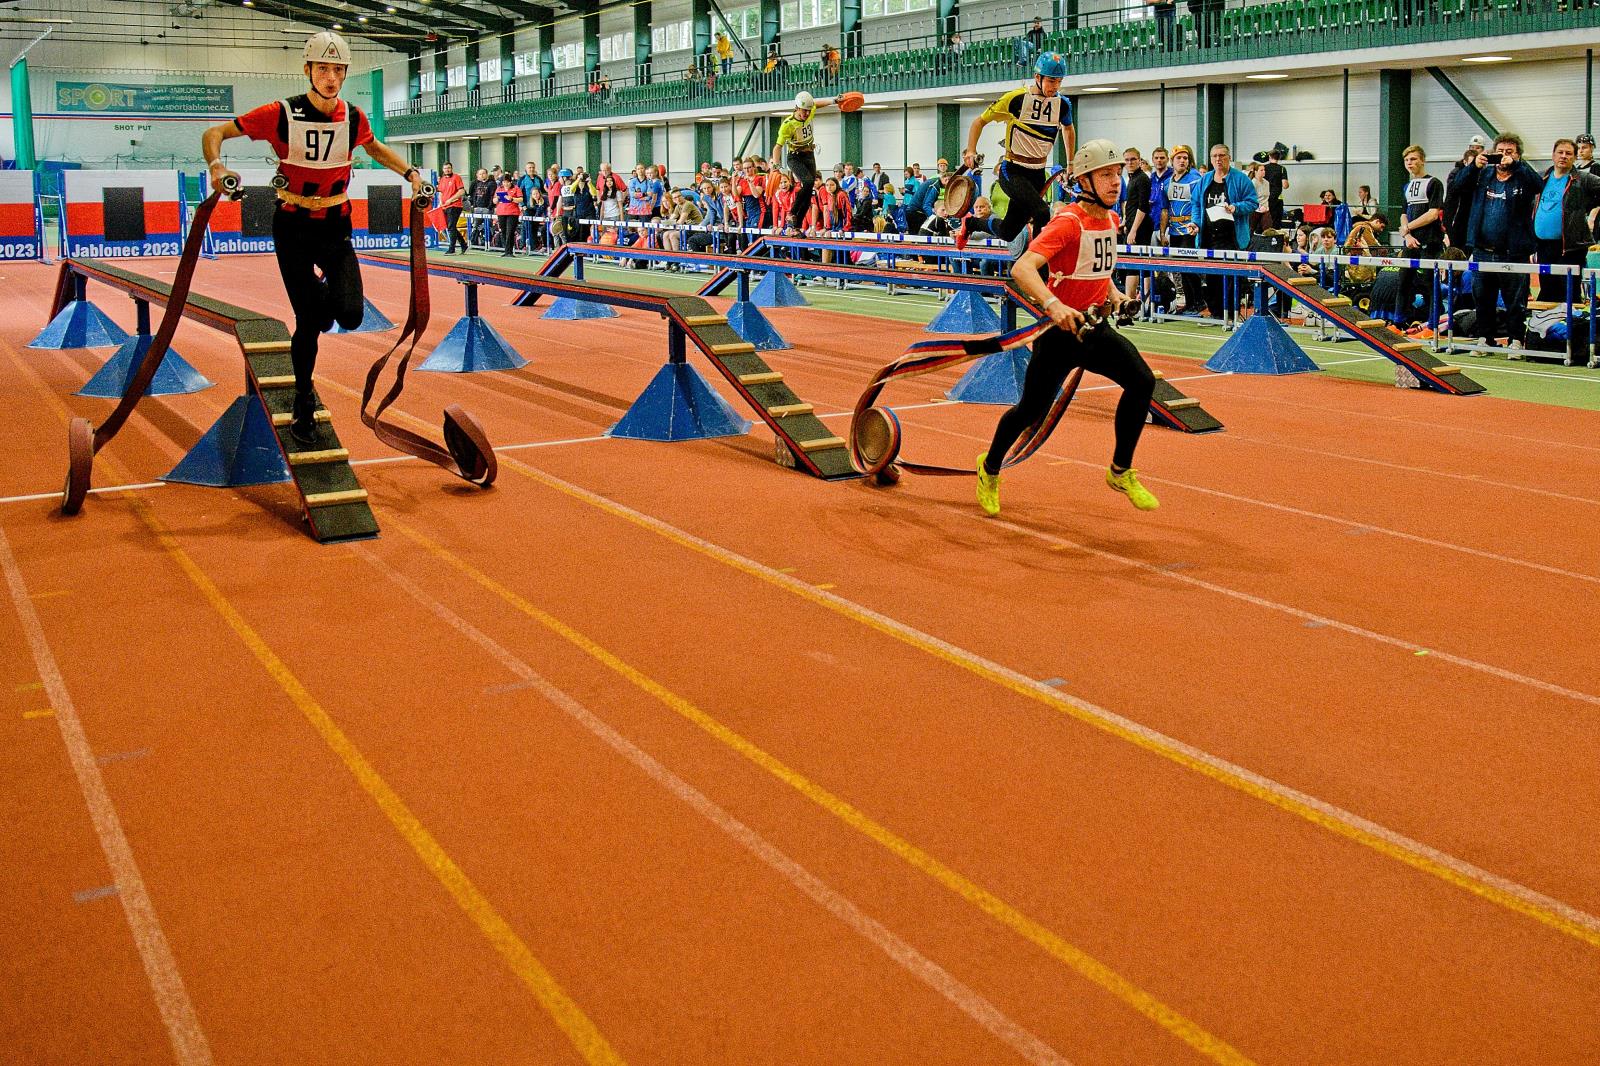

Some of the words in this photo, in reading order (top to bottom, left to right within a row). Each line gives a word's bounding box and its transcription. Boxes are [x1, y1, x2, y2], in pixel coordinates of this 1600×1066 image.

[59, 84, 136, 110] SPORT
[144, 104, 228, 112] www.sportjablonec.cz
[1031, 100, 1052, 122] 94
[802, 124, 812, 138] 93
[306, 130, 335, 161] 97
[1409, 181, 1420, 197] 48
[215, 239, 274, 252] Jablonec
[350, 236, 398, 248] ablonec
[400, 234, 431, 247] 23
[72, 244, 140, 258] Jablonec
[143, 242, 179, 256] 2023
[1092, 236, 1112, 272] 96
